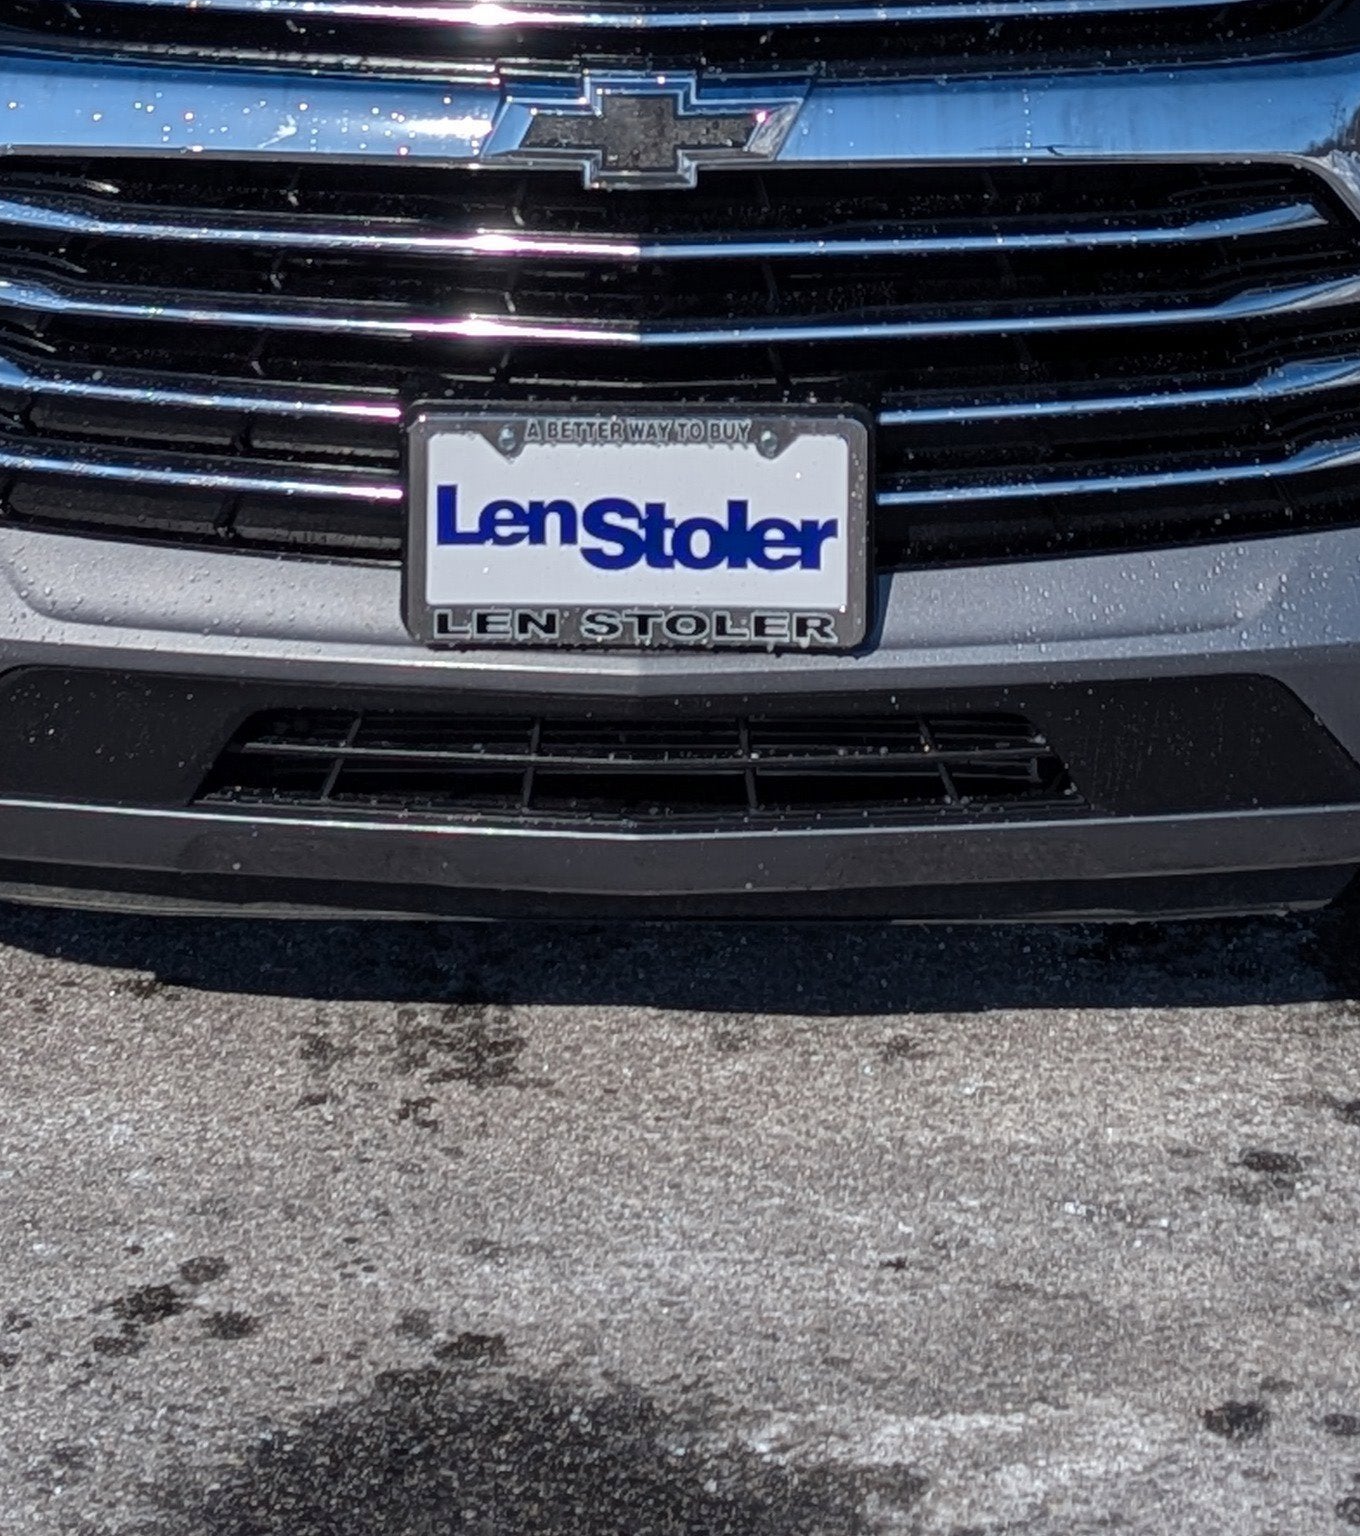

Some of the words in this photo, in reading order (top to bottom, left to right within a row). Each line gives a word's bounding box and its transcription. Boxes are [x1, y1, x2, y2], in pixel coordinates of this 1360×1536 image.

[524, 419, 541, 441] A
[545, 419, 625, 441] BETTER
[626, 419, 674, 441] WAY
[677, 419, 706, 441] TO
[708, 419, 753, 441] BUY
[434, 609, 560, 640] LEN
[579, 610, 838, 643] STOLER
